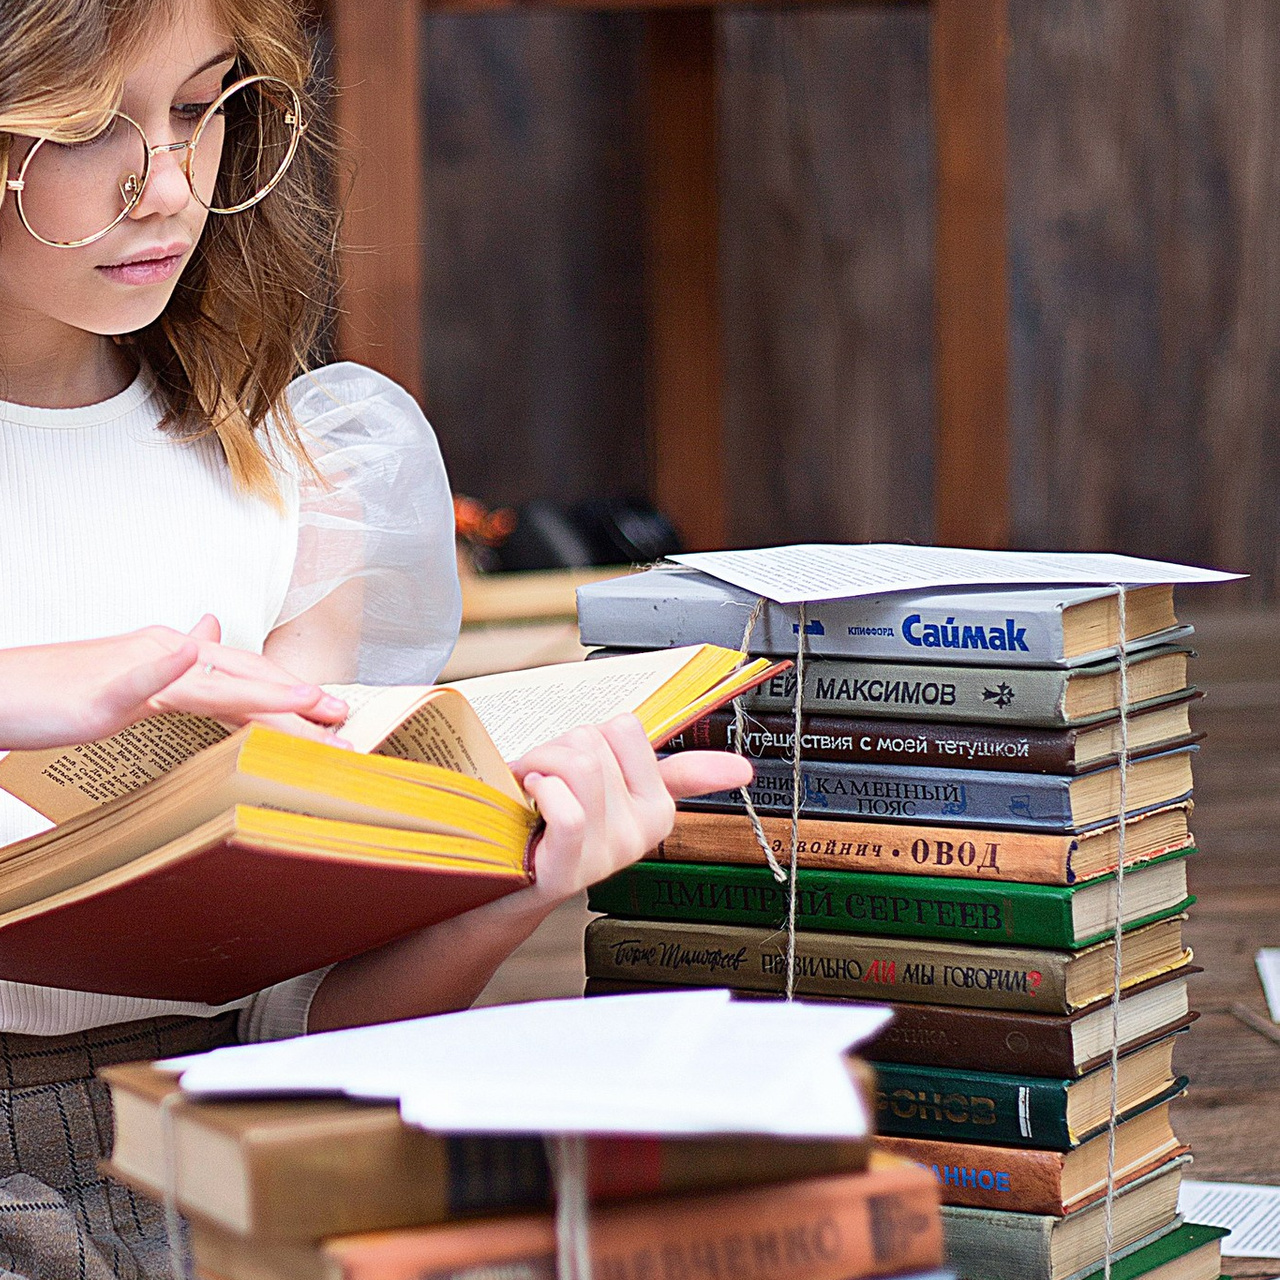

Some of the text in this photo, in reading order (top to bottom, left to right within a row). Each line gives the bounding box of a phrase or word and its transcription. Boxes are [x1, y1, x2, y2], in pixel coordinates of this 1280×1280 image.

[848, 614, 1029, 652] КЛИФФОРД Саймак
[815, 677, 957, 706] МАКСИМОВ
[726, 725, 853, 751] Путешествия
[859, 737, 872, 751] с
[877, 735, 928, 754] моей
[935, 739, 1030, 759] тетушкой
[40, 769, 67, 787] умеет.
[816, 777, 960, 803] КАМЕННЫЙ
[857, 797, 916, 816] ПОЯС
[911, 838, 1001, 876] ОВОД
[652, 878, 1003, 931] ДМИТРИЙ СЕРГЕЕВ
[761, 952, 861, 980] ПРАВИЛЬНО
[863, 959, 896, 986] ЛИ
[902, 963, 934, 986] МЫ
